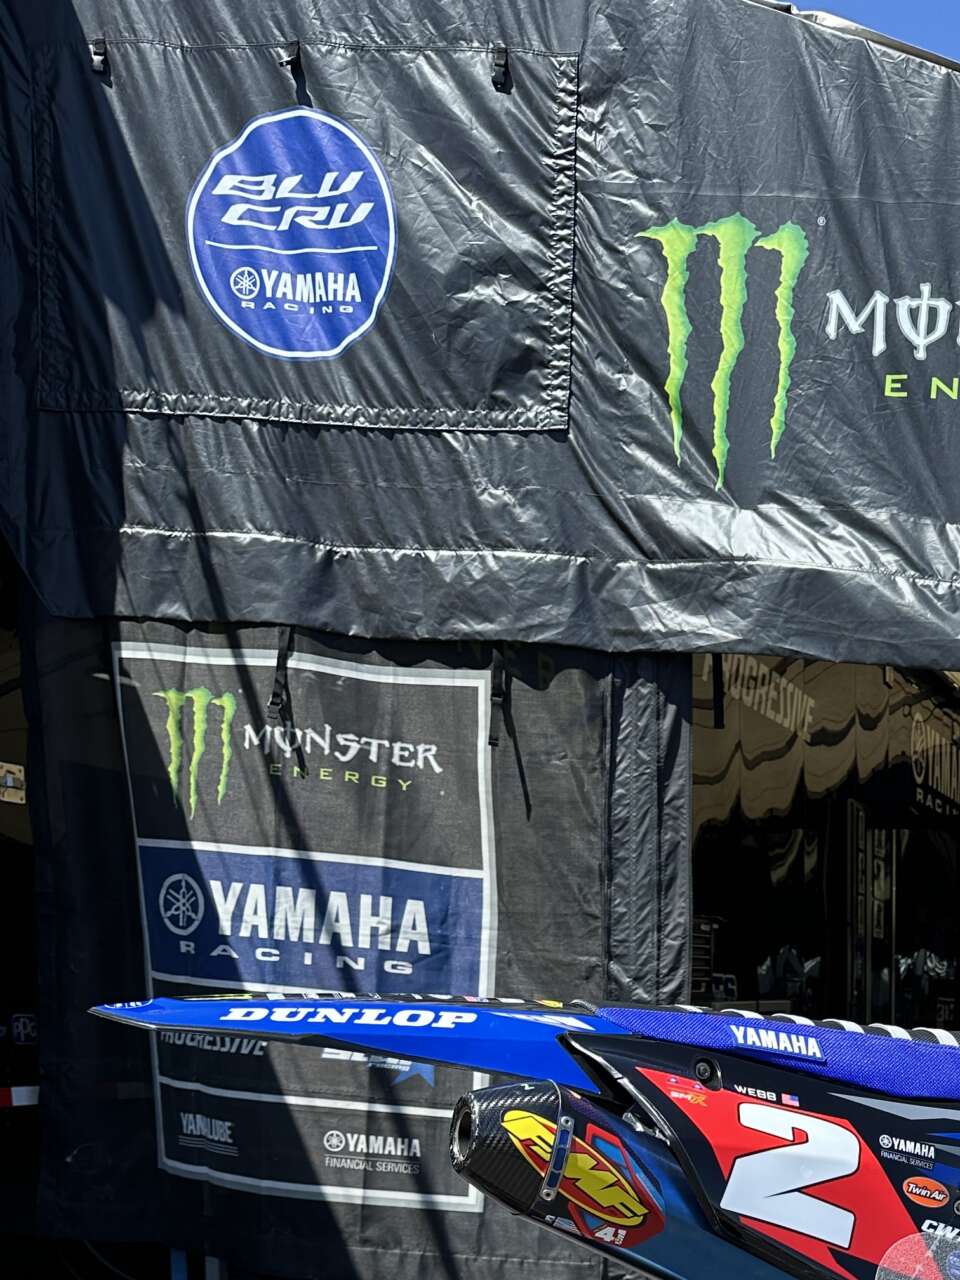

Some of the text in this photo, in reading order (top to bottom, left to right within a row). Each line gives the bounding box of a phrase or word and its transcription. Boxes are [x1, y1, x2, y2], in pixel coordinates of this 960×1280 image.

[211, 171, 364, 200] BLU
[221, 202, 375, 231] CRU
[261, 268, 362, 303] YAMAHA
[241, 301, 354, 315] RACING
[243, 722, 443, 774] MONSTER
[269, 763, 413, 792] ENERGY
[209, 879, 432, 956] YAMAHA
[180, 940, 414, 975] RACING
[219, 1007, 478, 1029] DUNLOP
[729, 1024, 823, 1058] YAMAHA
[733, 1083, 778, 1102] WEBB
[346, 1132, 421, 1158] YAMAHA
[892, 1137, 936, 1160] YAMAHA
[324, 1156, 421, 1175] FINANCIAL SERVICES
[881, 1150, 934, 1170] FINANCIAL SERVICES
[719, 1102, 862, 1250] 2
[907, 1182, 947, 1201] Twin Air
